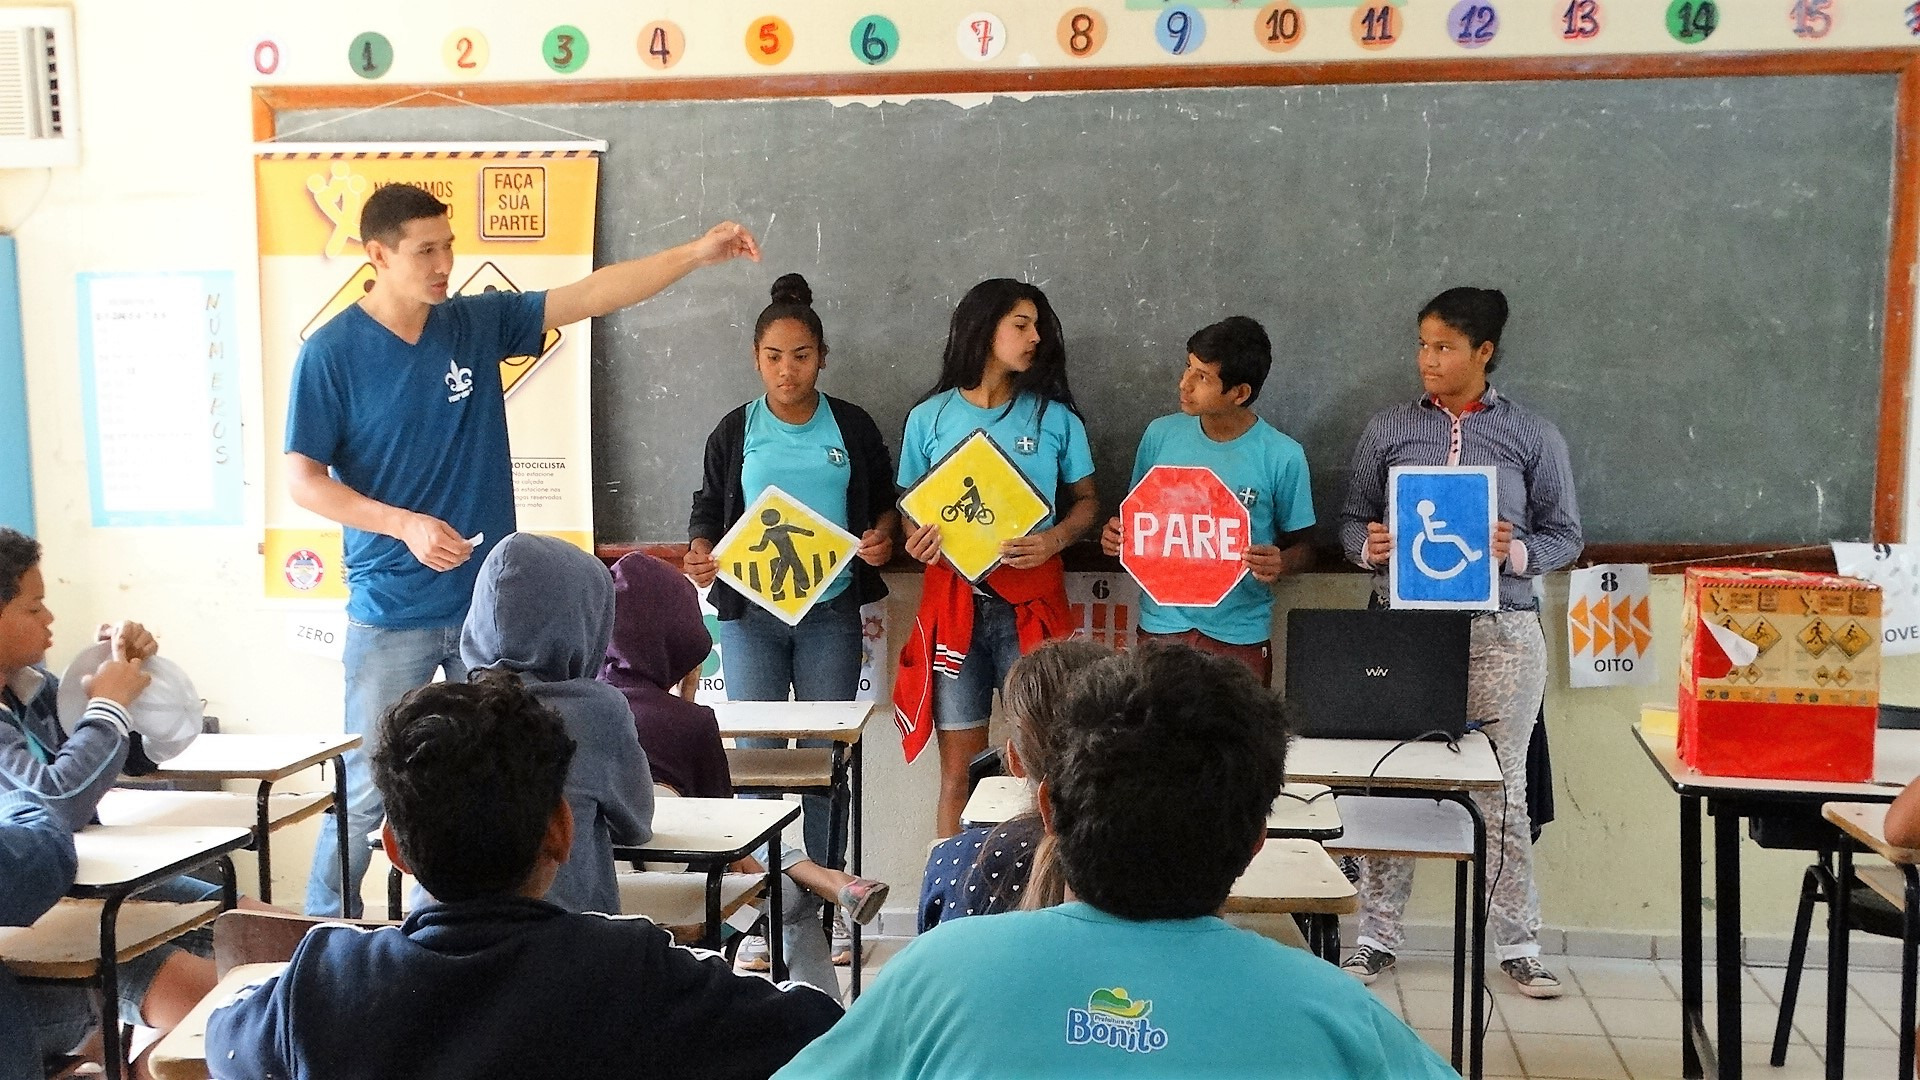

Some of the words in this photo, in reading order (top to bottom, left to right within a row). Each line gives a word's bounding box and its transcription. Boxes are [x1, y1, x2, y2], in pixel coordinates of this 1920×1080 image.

[1070, 14, 1095, 56] 8
[1167, 11, 1191, 55] 9
[1266, 8, 1300, 43] 10
[1361, 6, 1395, 44] 11
[1458, 5, 1495, 43] 12
[1562, 0, 1599, 39] 13
[1678, 1, 1717, 39] 14
[1790, 0, 1832, 38] 15
[456, 37, 477, 68] 2
[553, 34, 574, 68] 3
[650, 27, 670, 64] 4
[759, 23, 779, 55] 5
[861, 22, 889, 64] 6
[971, 20, 993, 56] 7
[254, 40, 279, 75] 0
[362, 41, 377, 72] 1
[495, 173, 533, 192] FAÇA
[499, 194, 530, 210] SUA
[490, 215, 538, 231] PARTE
[1133, 512, 1242, 561] PARE
[1092, 579, 1110, 600] 6
[1600, 572, 1619, 592] 8
[297, 625, 334, 644] ZERO
[1884, 626, 1919, 643] OVE
[1594, 659, 1634, 673] OITO
[698, 678, 724, 691] TRO
[1067, 1009, 1168, 1053] Bonito
[1094, 1014, 1125, 1026] Prefeitura
